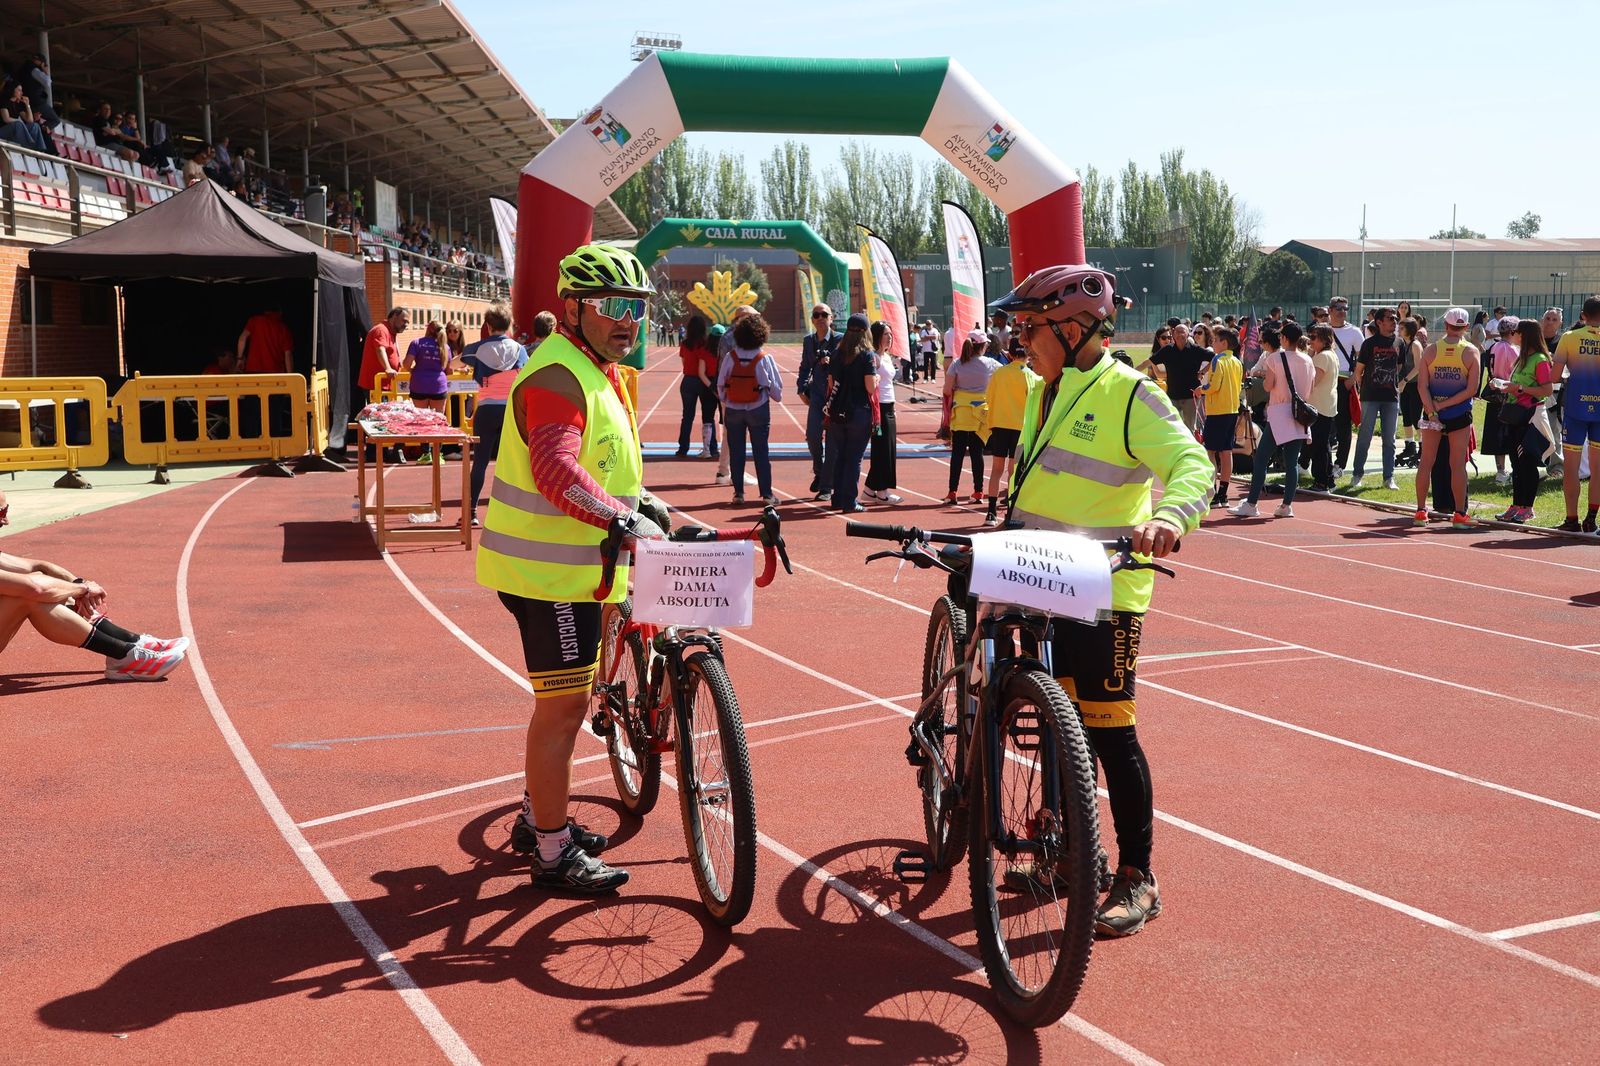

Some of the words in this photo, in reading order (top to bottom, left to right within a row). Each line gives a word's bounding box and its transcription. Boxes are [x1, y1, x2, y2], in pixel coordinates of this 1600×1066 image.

[599, 127, 656, 180] AYUNTAMIENTO
[603, 172, 619, 187] DE
[618, 136, 662, 174] ZAMORA
[951, 134, 1008, 186] AYUNTAMIENTO
[943, 139, 960, 155] DE
[958, 153, 1000, 193] ZAMORA
[705, 227, 737, 240] CAJA
[741, 228, 787, 240] RURAL
[1434, 372, 1461, 381] DUERO
[1005, 541, 1075, 563] PRIMERA
[664, 565, 728, 577] PRIMERA
[1017, 555, 1062, 576] DAMA
[674, 581, 716, 592] DAMA
[997, 568, 1076, 597] ABSOLUTA
[656, 595, 730, 608] ABSOLUTA
[1103, 629, 1126, 692] Camino
